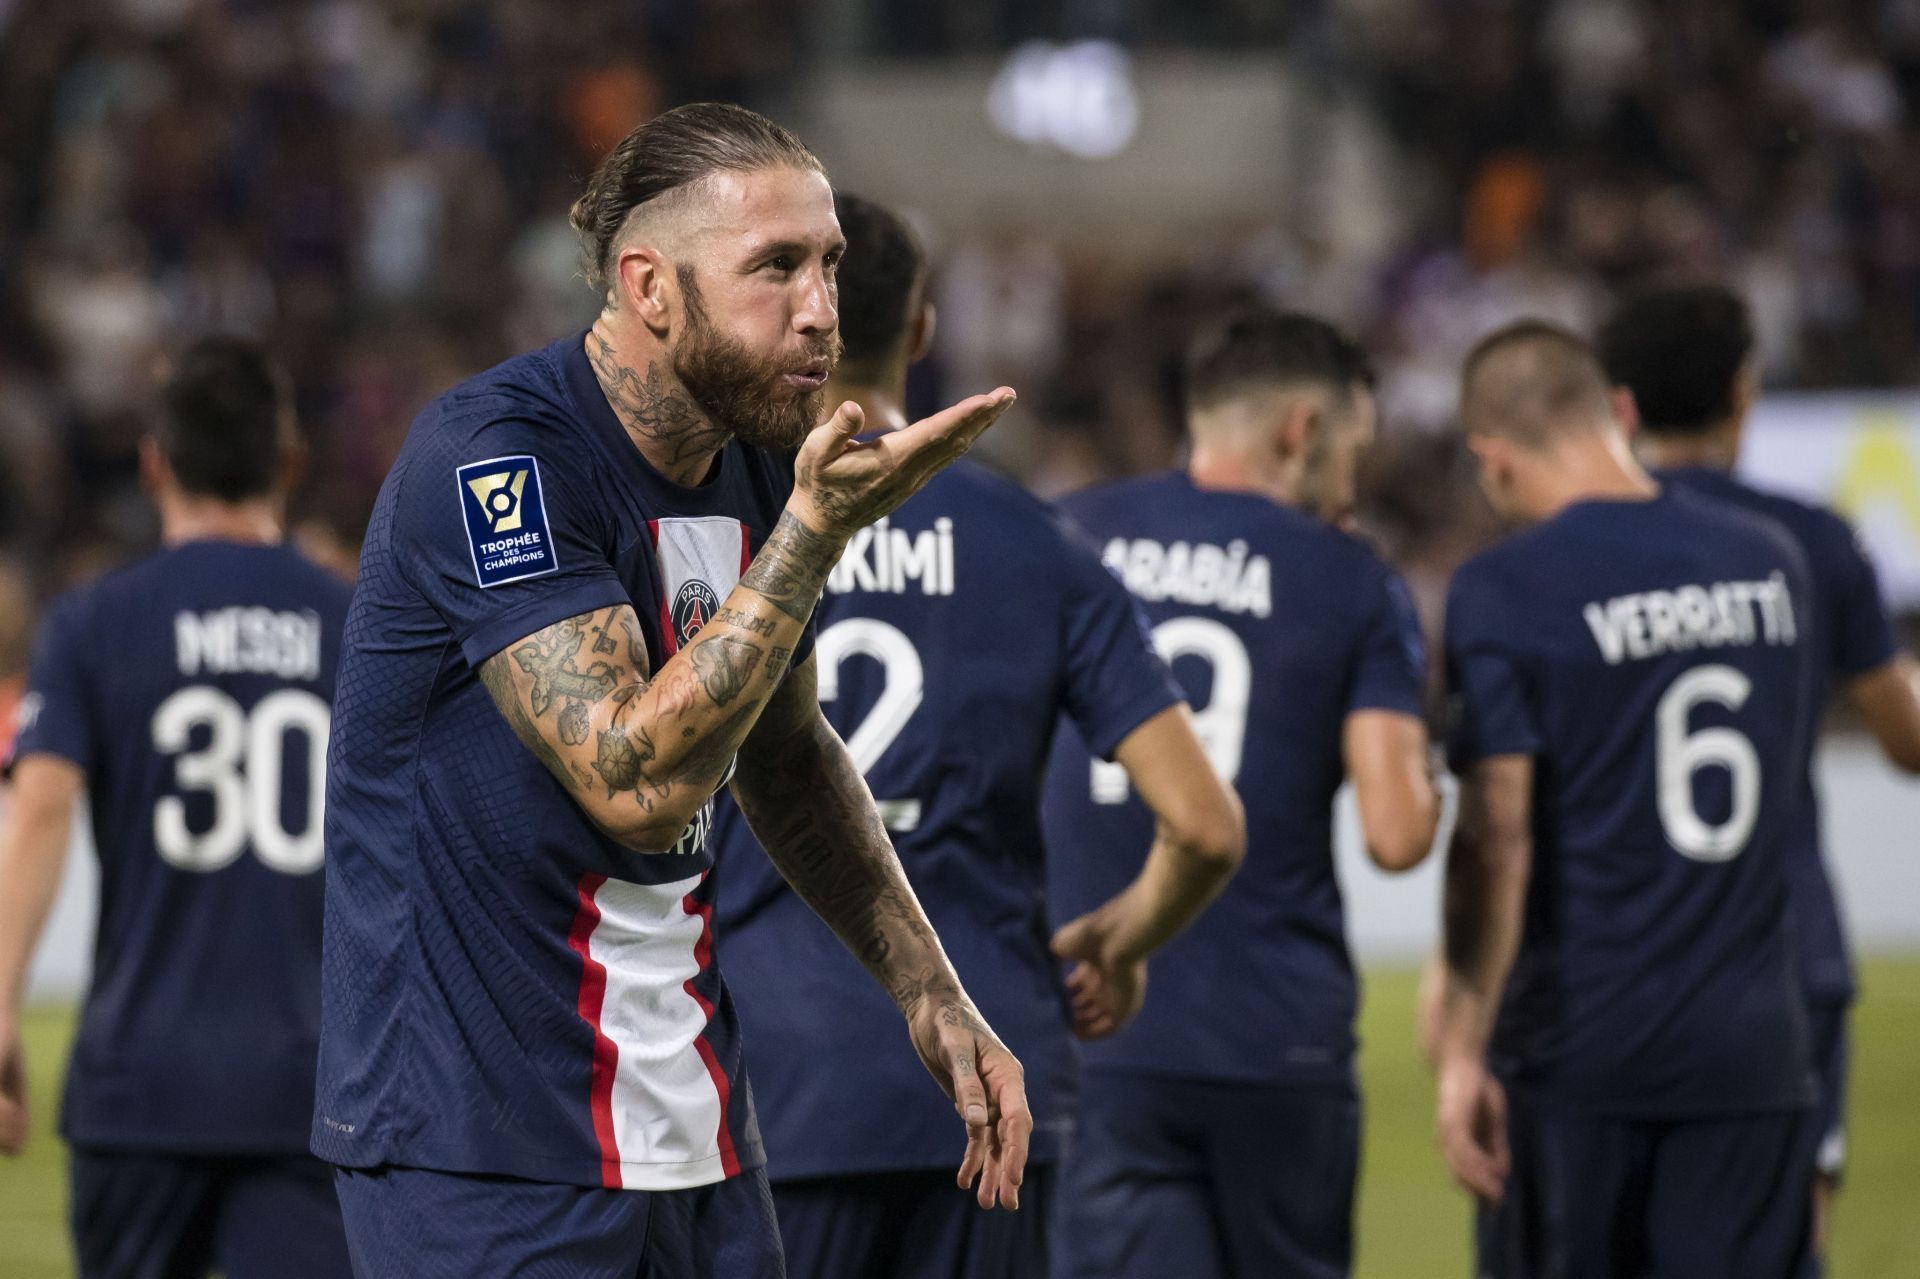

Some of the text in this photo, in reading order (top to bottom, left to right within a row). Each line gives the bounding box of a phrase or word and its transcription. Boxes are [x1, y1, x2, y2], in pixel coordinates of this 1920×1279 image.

[480, 532, 541, 555] TROPHÉE
[484, 550, 545, 571] CHAMPIONS
[503, 548, 520, 557] DES
[826, 514, 954, 596] KIMI
[1101, 536, 1272, 619] ARABIA
[682, 585, 712, 604] PARIS
[1583, 568, 1797, 664] VERRATTI
[151, 685, 331, 877] 30
[1654, 663, 1762, 863] 6
